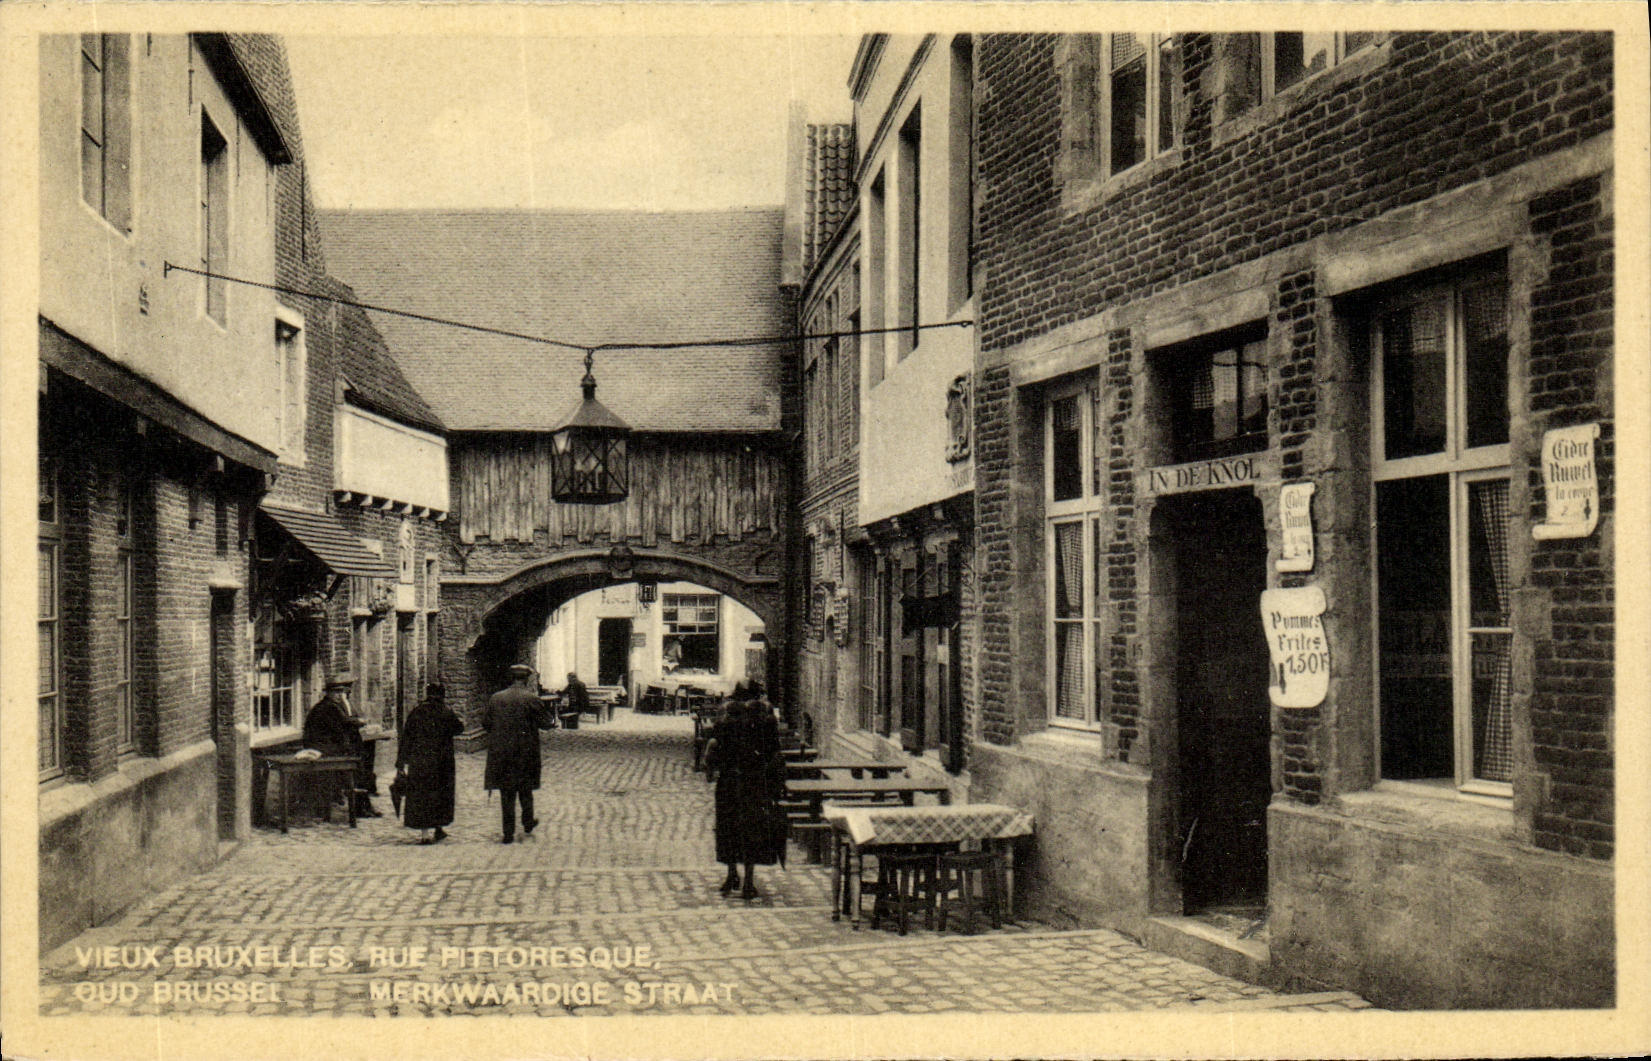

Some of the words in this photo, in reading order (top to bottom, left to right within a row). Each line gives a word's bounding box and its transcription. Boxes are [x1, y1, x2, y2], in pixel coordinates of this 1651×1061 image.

[1552, 440, 1588, 460] Cidre
[1149, 470, 1168, 491] IN
[1176, 466, 1200, 487] DE
[1207, 458, 1260, 484] KNOL
[1271, 611, 1320, 630] Pommes
[1278, 633, 1321, 651] Frites
